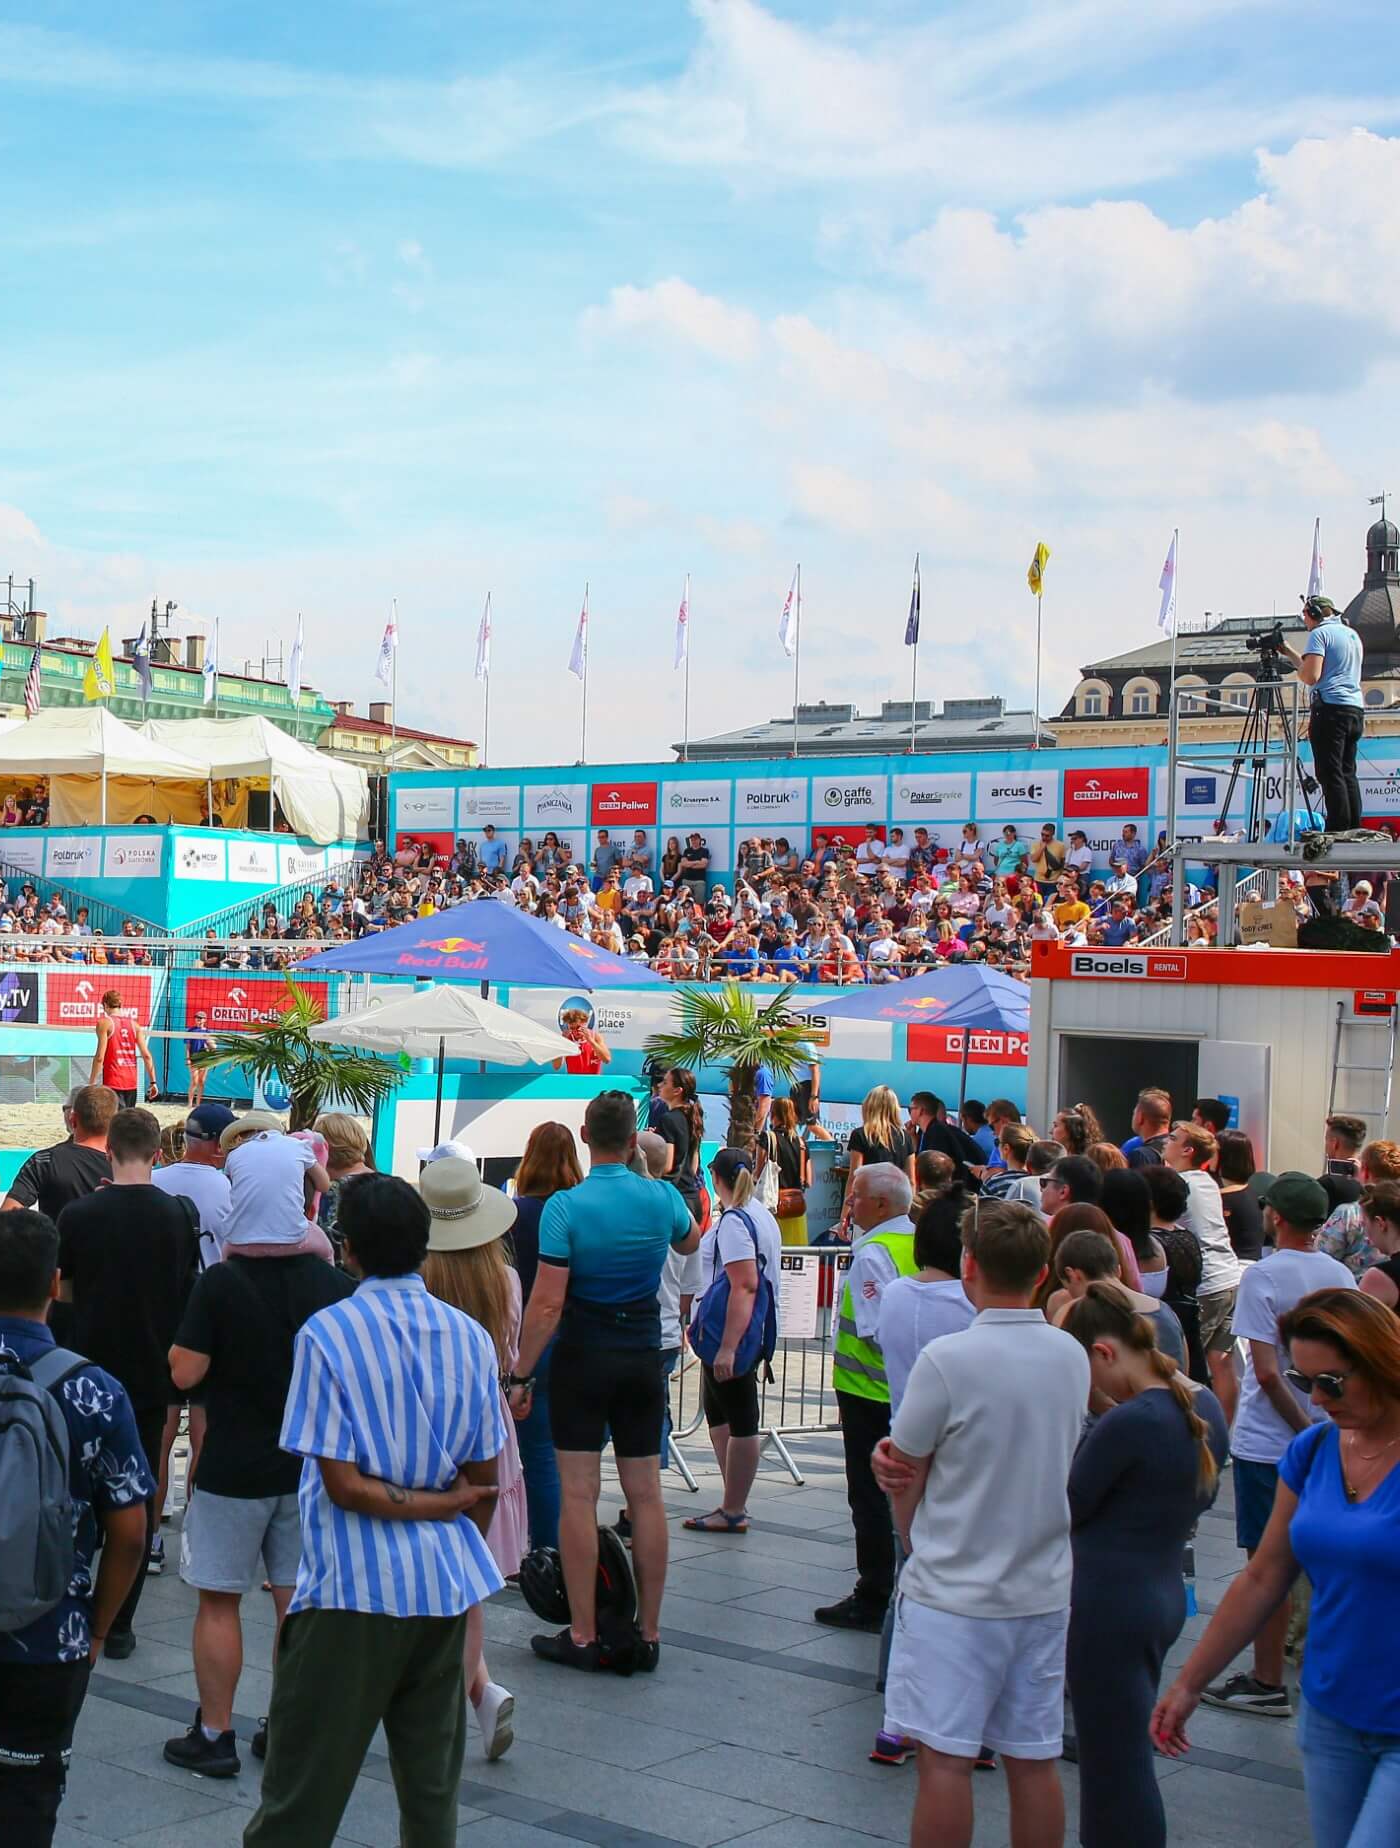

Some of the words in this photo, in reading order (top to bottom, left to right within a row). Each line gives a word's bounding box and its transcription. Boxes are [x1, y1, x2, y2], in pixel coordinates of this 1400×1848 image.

[844, 787, 872, 798] caffe
[991, 787, 1026, 798] arcus
[1265, 776, 1282, 800] GK
[1365, 787, 1400, 796] MAŁOPO
[747, 793, 790, 804] Polbruk
[1074, 791, 1101, 801] ORLEN
[1102, 790, 1138, 800] Paliwa
[621, 801, 648, 810] Paliwa
[844, 796, 872, 807] grano
[53, 849, 84, 860] Polbruk
[397, 953, 446, 968] Red
[449, 955, 489, 970] Bull
[1075, 956, 1144, 974] Boels
[1153, 962, 1180, 972] RENTAL
[61, 1003, 93, 1017] ORLEN
[212, 1006, 248, 1022] ORLEN
[598, 1007, 633, 1020] fitness
[598, 1018, 626, 1030] place
[820, 1119, 857, 1130] itness
